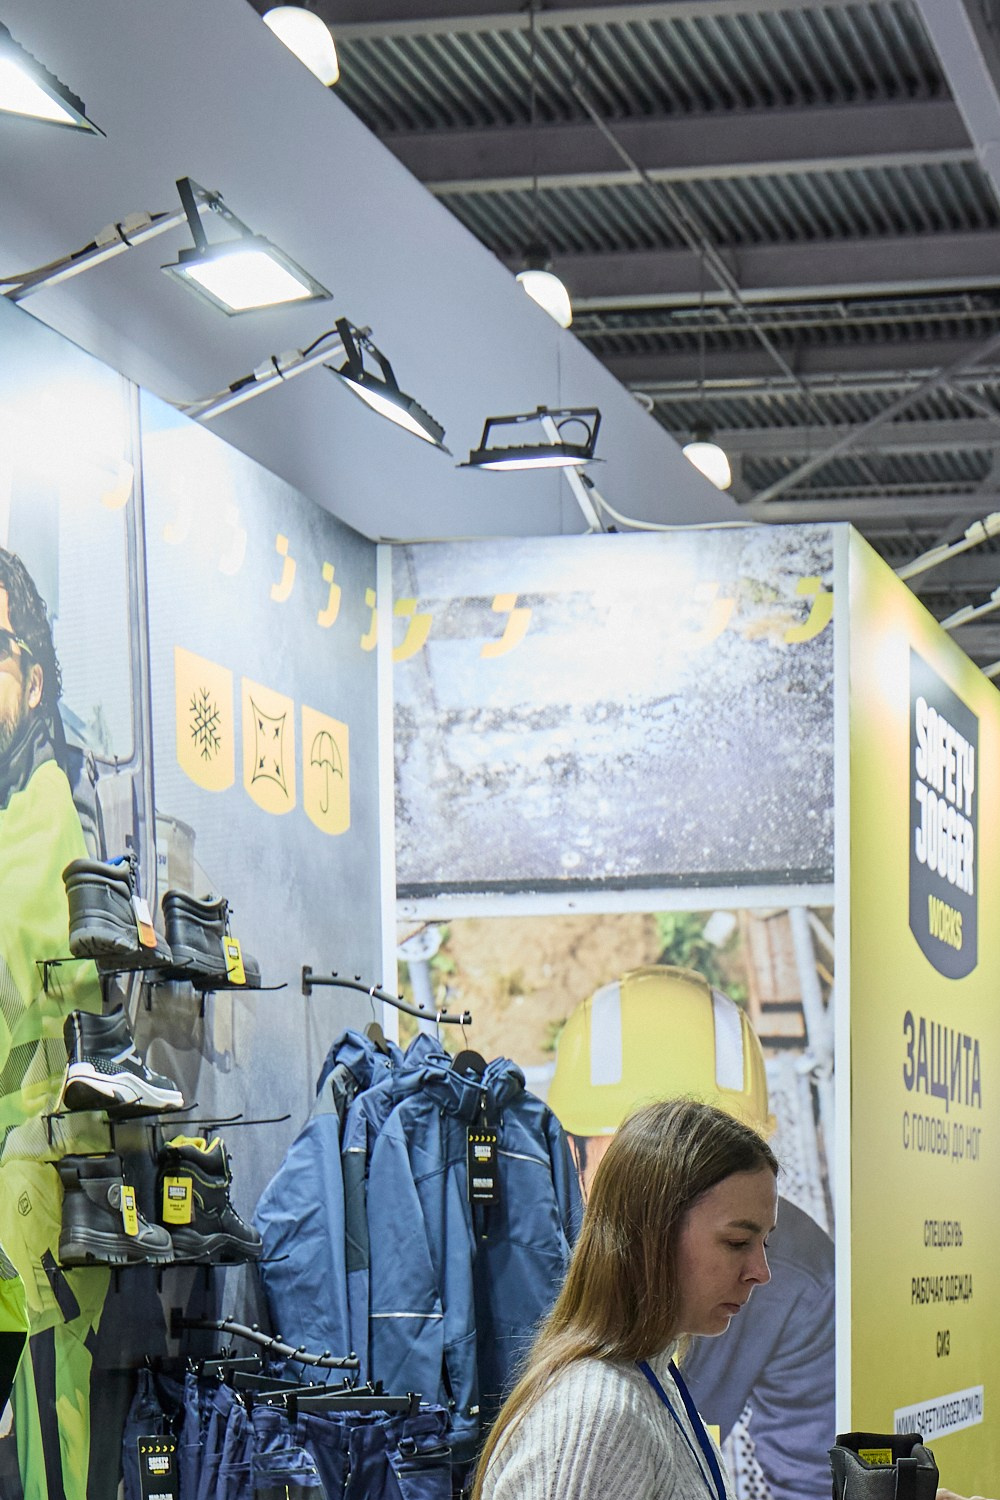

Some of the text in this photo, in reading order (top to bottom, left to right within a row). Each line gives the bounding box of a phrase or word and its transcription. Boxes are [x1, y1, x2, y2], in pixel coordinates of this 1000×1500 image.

[915, 695, 975, 817] SAFETY
[915, 779, 975, 896] JOGGER
[928, 894, 963, 951] WORKS
[903, 1010, 982, 1113] ЗАЩИТА
[902, 1111, 982, 1163] С ГОЛОВЫ ДО НОГ
[923, 1219, 963, 1251] СПЕЦОБУВЬ
[911, 1274, 973, 1305] РАБОЧАЯ ОДЕЖДА
[936, 1330, 951, 1358] СИЗ
